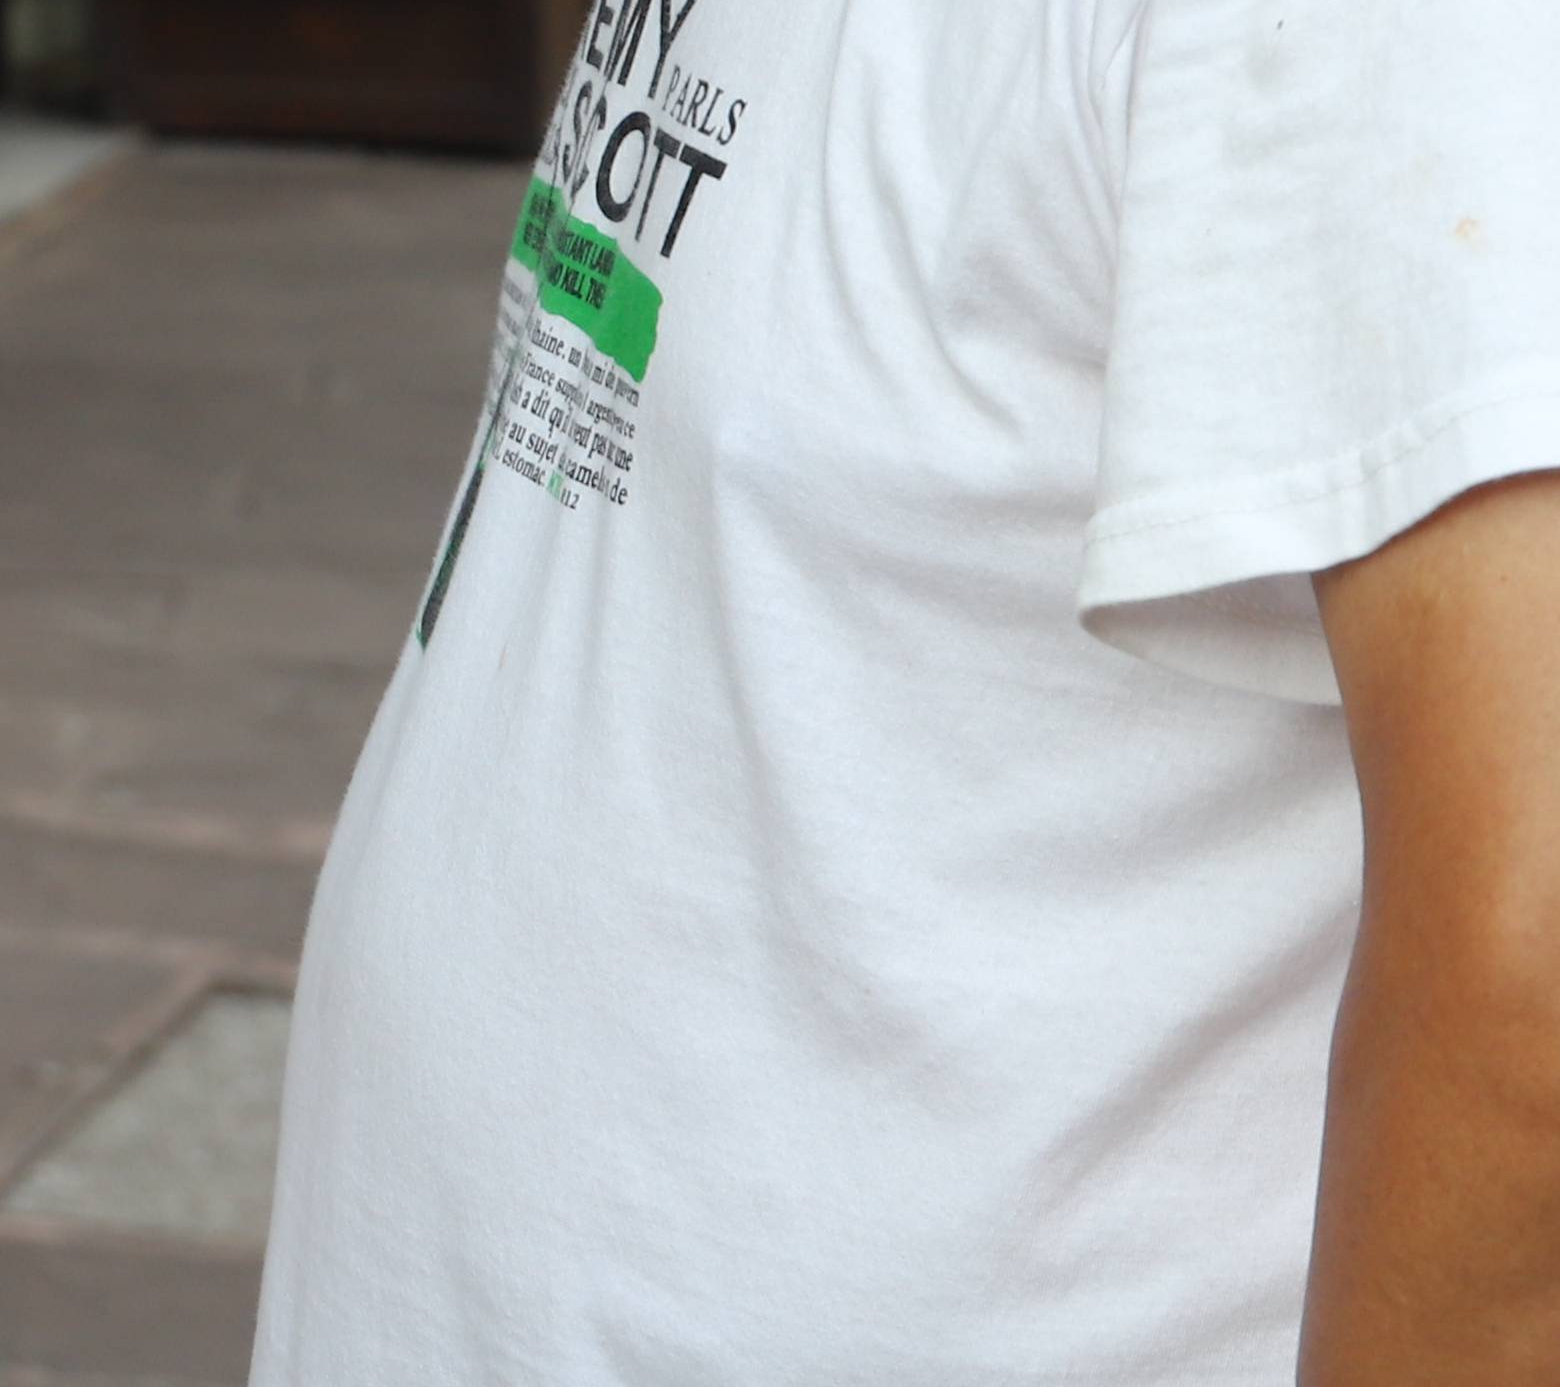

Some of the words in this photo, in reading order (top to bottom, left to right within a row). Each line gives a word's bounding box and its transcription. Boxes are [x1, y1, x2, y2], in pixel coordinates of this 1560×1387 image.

[561, 79, 729, 259] SCOTT
[522, 392, 531, 408] a
[531, 388, 551, 420] dit
[509, 423, 526, 443] au
[526, 431, 560, 465] sujet
[609, 478, 629, 505] de
